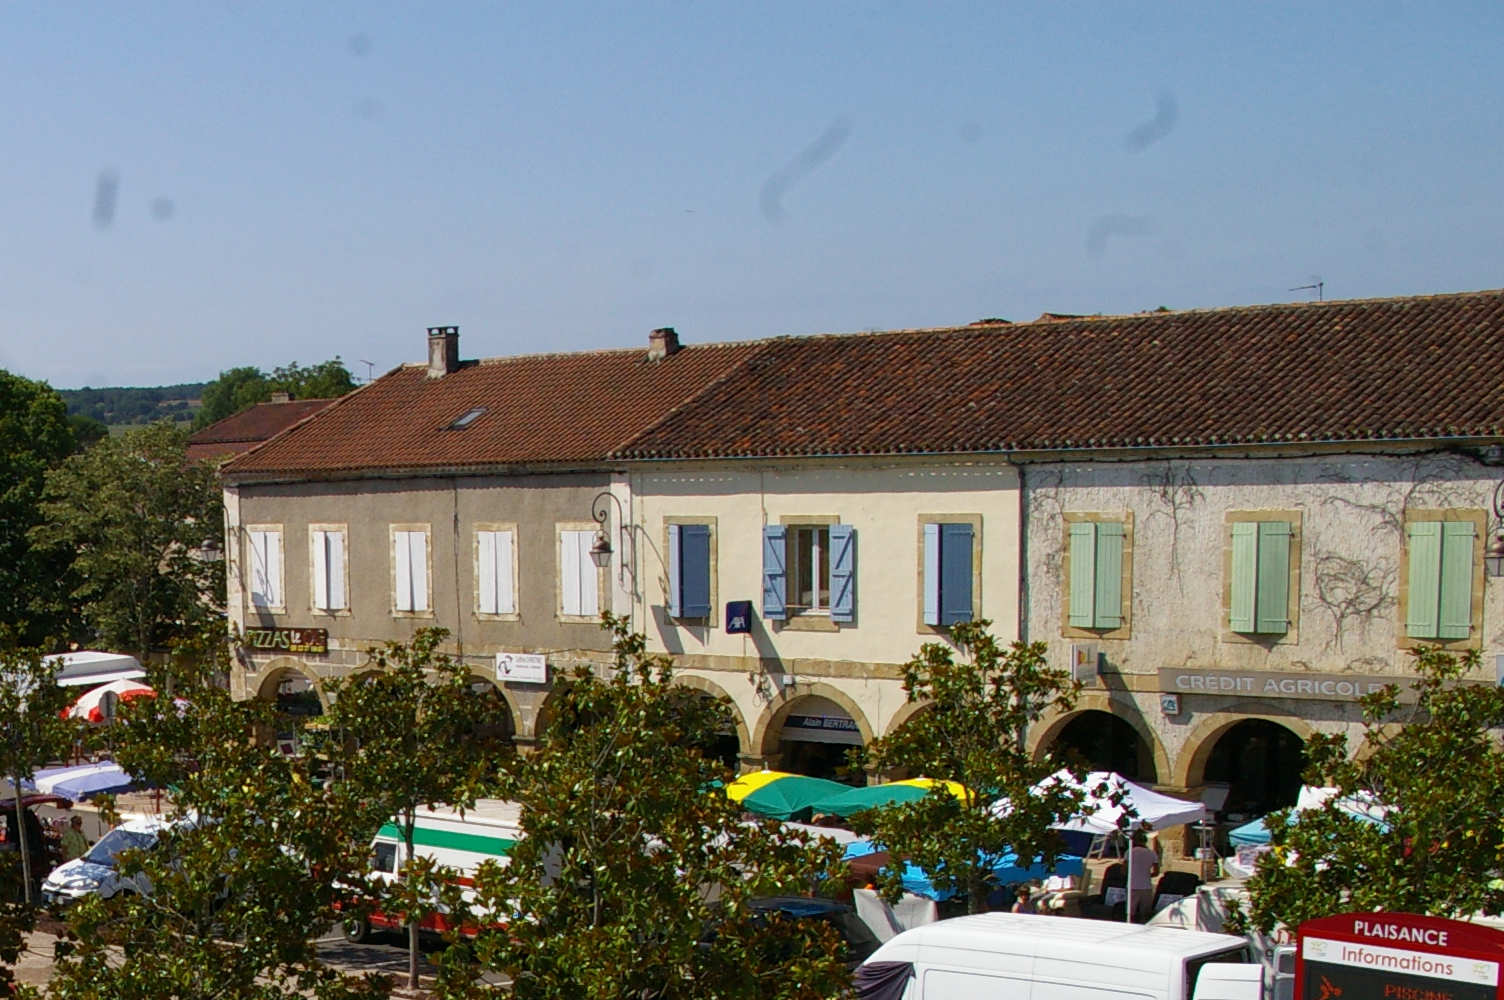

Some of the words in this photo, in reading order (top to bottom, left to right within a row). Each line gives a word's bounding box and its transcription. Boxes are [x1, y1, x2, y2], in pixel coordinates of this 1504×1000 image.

[1175, 673, 1256, 692] CRÉDIT
[1263, 677, 1384, 697] AGRICOLE
[802, 717, 823, 728] Alain
[1354, 920, 1449, 947] PLAISANCE
[1342, 946, 1454, 976] Informations
